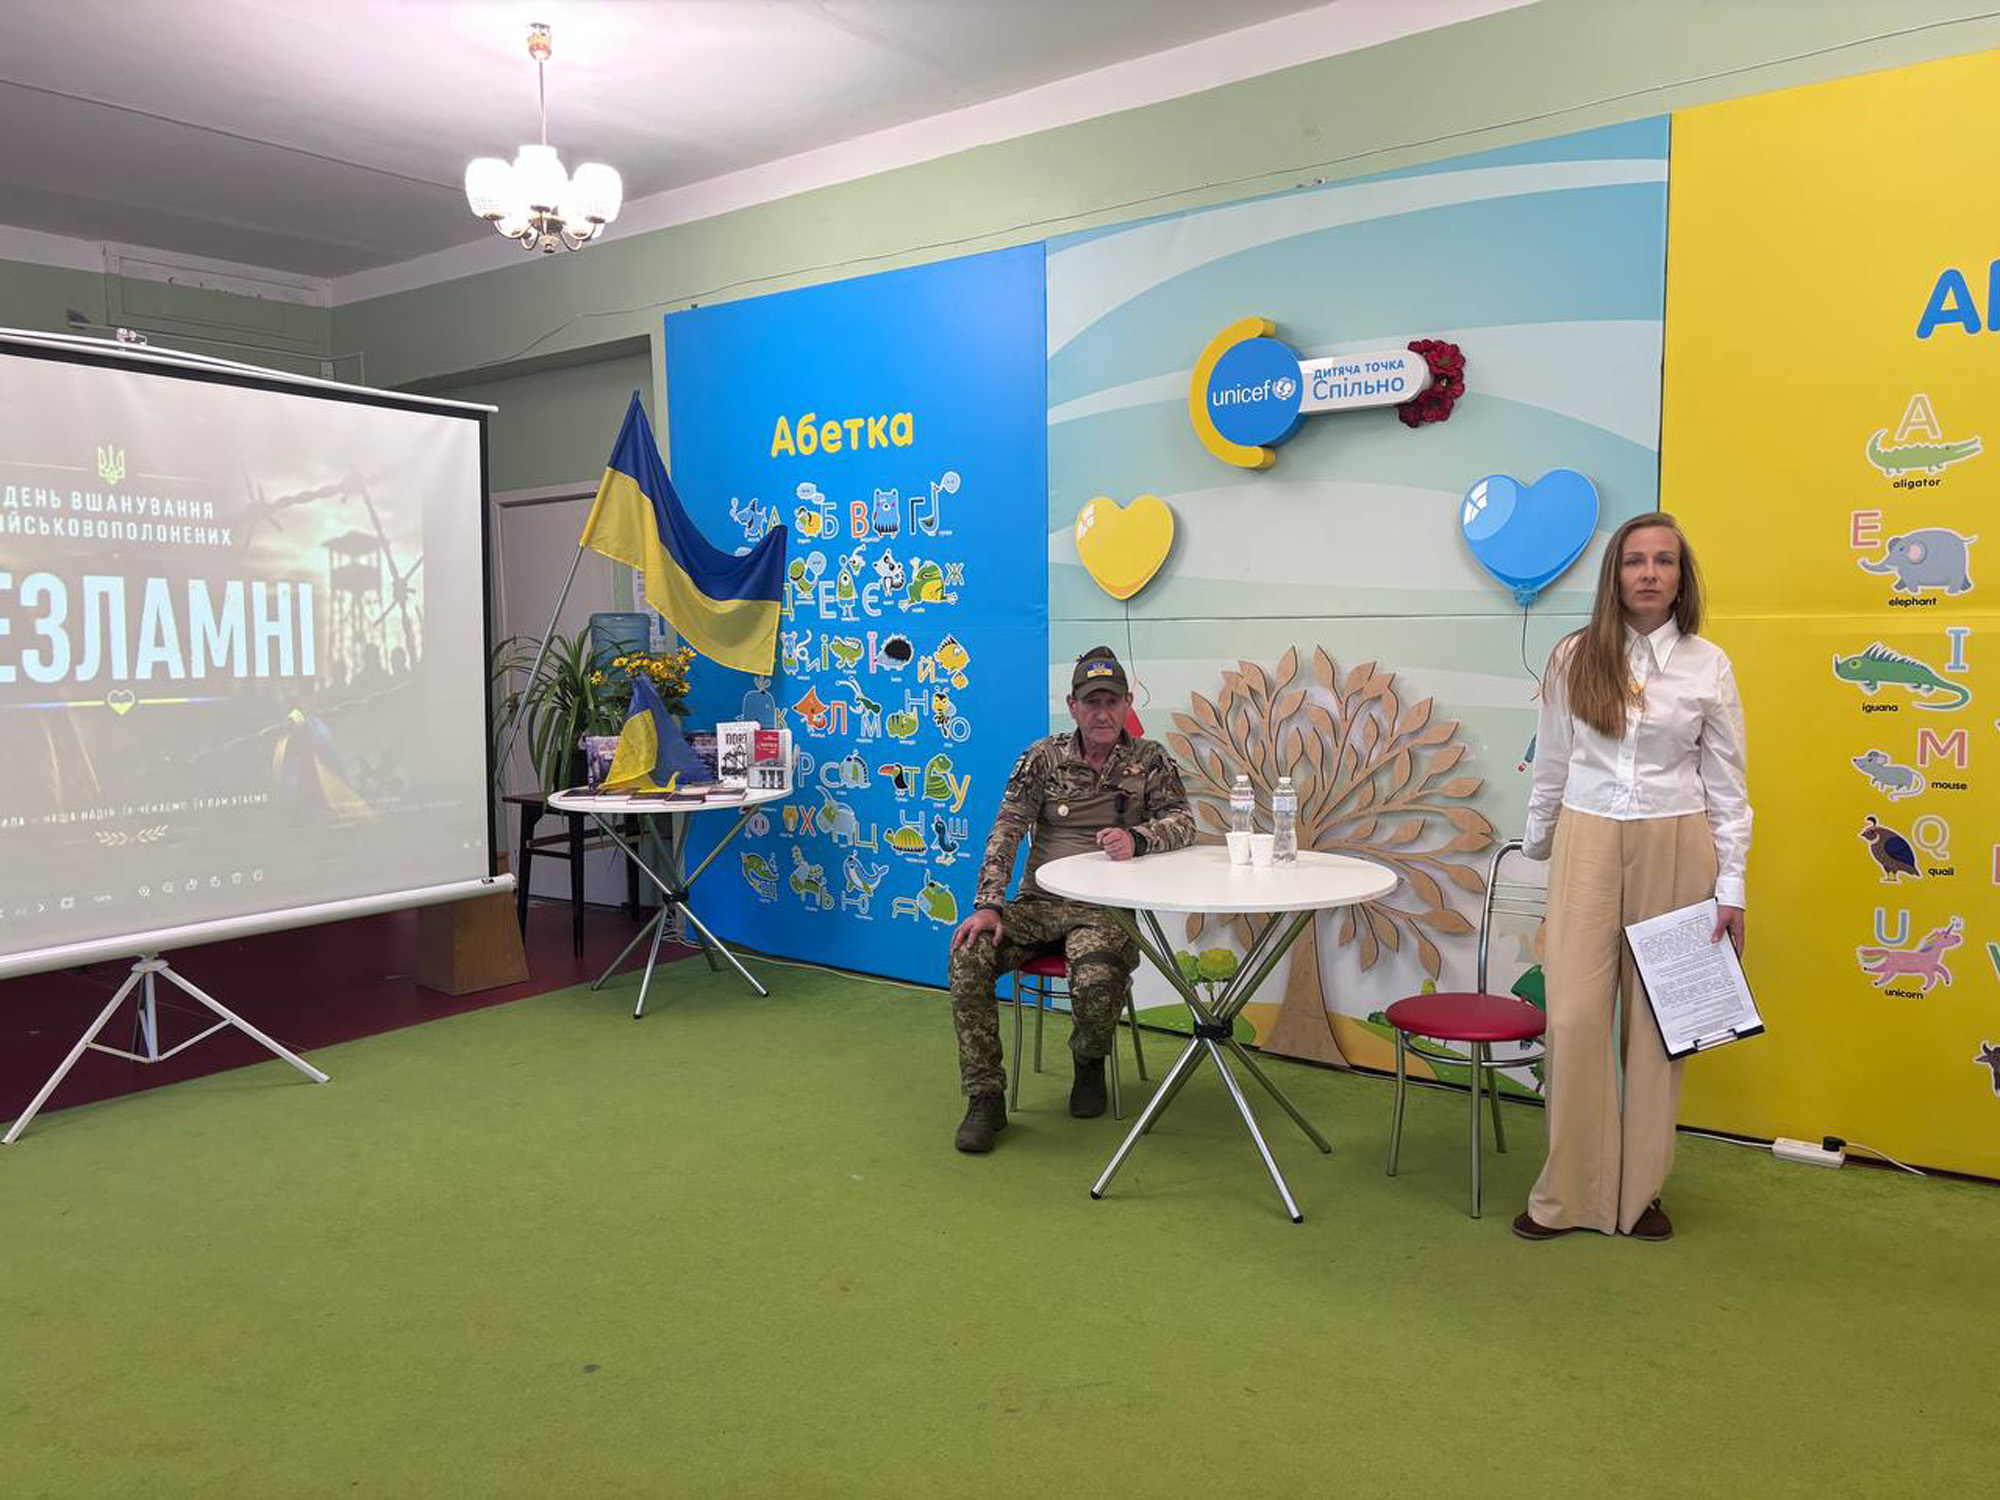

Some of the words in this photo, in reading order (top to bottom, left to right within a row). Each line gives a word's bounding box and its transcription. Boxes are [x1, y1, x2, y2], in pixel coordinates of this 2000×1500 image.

[1313, 364, 1361, 381] ДИТЯЧА
[1365, 358, 1405, 376] ТОЧКА
[1212, 379, 1271, 406] unicef
[1313, 376, 1405, 400] Спільно
[771, 412, 913, 458] Абетка
[1893, 476, 1941, 489] aligator
[4, 485, 62, 509] ДЕНЬ
[71, 490, 215, 520] ВШАНУВАННЯ
[850, 500, 869, 538] В
[1888, 596, 1937, 609] elephant
[1862, 702, 1899, 713] iguana
[1931, 780, 1968, 791] mouse
[1928, 866, 1955, 877] quail
[1885, 987, 1924, 1000] unicorn
